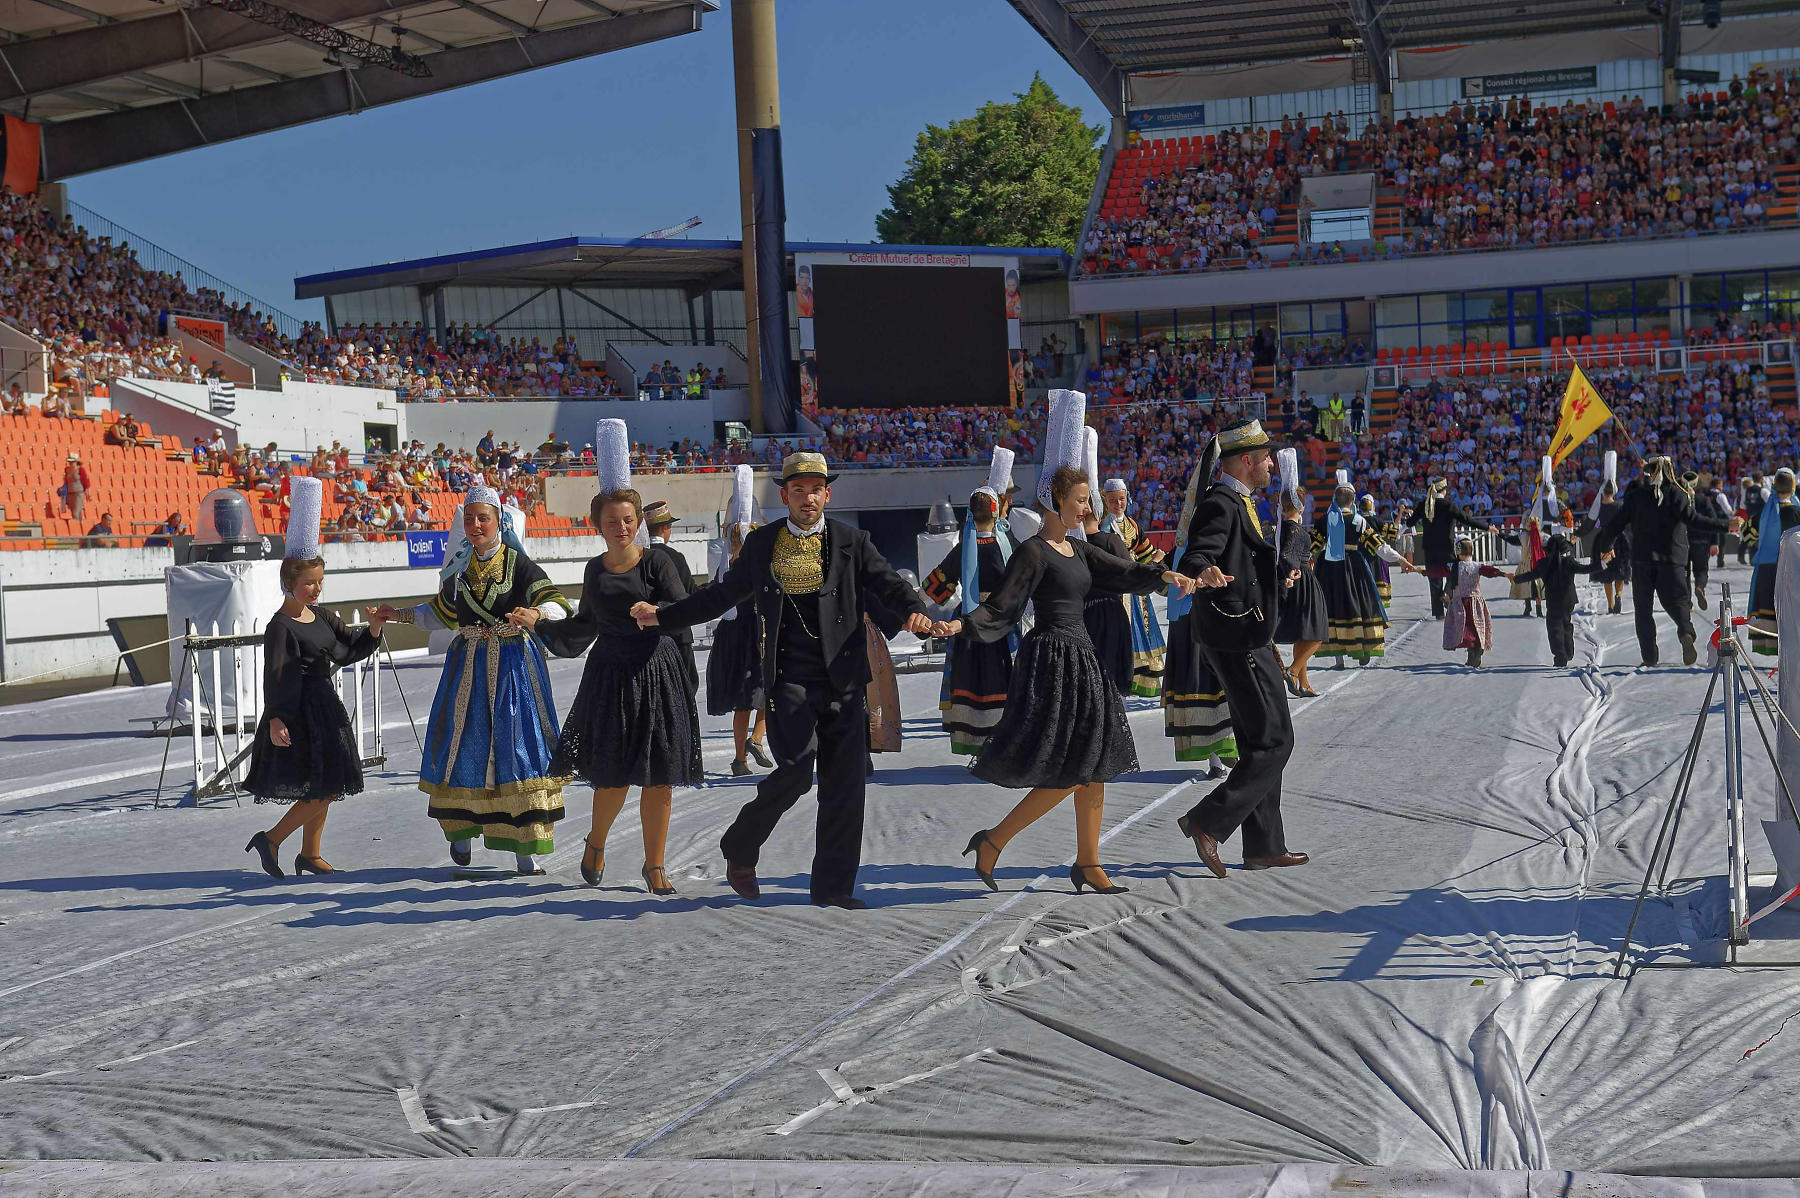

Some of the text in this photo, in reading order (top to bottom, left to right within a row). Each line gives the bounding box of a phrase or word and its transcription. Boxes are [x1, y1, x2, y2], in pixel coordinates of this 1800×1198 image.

[1486, 79, 1513, 88] Conseil
[1546, 74, 1556, 82] de
[1558, 72, 1592, 82] Bretagne
[849, 252, 967, 266] Crédit Mutuel de Bretagne
